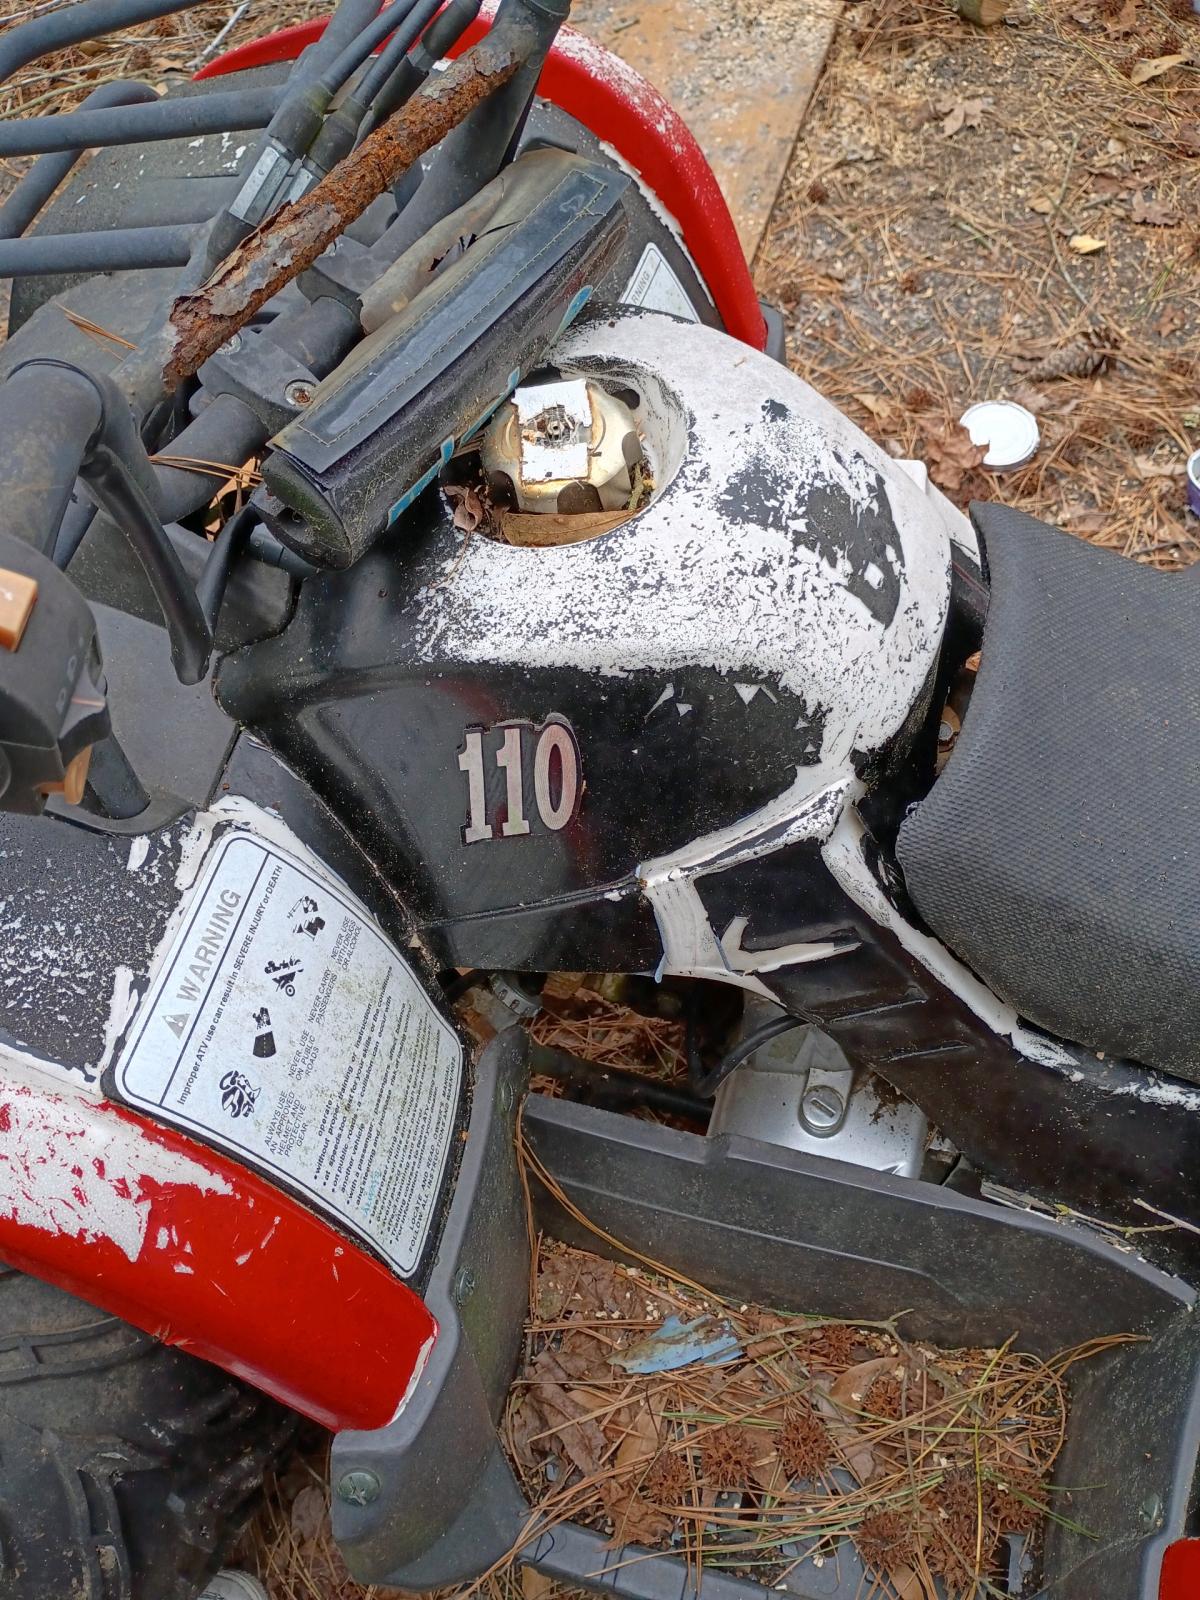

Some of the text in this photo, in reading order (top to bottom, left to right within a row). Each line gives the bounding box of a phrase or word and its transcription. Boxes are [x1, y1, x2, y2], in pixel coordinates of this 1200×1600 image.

[631, 271, 651, 304] RNING
[458, 724, 578, 844] 110
[178, 888, 240, 1003] WARNING
[331, 916, 350, 959] NEVER USE
[335, 920, 355, 965] WITH DRUGS
[340, 926, 361, 970] OR ALCOHOL
[177, 1062, 200, 1104] Improper
[196, 1041, 208, 1061] ATV
[205, 1025, 216, 1041] use
[213, 1007, 223, 1024] can
[220, 980, 234, 1006] result
[229, 970, 238, 980] in
[234, 935, 253, 970] SEVERE
[249, 903, 265, 934] INJURY
[266, 865, 282, 894] DEATH
[308, 966, 331, 1023] NEVER CARRY
[315, 973, 337, 1023] PASSENGERS
[288, 1029, 309, 1078] NEVER USE
[294, 1035, 315, 1081] ON PUBLIC
[305, 1047, 319, 1076] ROADS
[329, 1133, 341, 1166] speeds
[344, 1094, 353, 1112] fast
[355, 1058, 364, 1080] your
[361, 1036, 371, 1058] skills
[377, 966, 392, 1007] conditions
[315, 1138, 330, 1173] without
[328, 1103, 340, 1135] proper
[338, 1066, 353, 1099] training
[354, 1003, 371, 1048] instruction
[337, 1144, 348, 1173] public
[347, 1114, 357, 1139] roads
[360, 1060, 373, 1097] collision
[378, 1013, 387, 1037] occur
[348, 1179, 357, 1198] with
[374, 1064, 390, 1115] passengers
[389, 1036, 398, 1060] affect
[395, 1003, 406, 1033] balance
[264, 1091, 287, 1146] ALWAYS USE
[268, 1091, 294, 1154] AN APPROVED
[277, 1099, 300, 1155] HELMET AND
[284, 1104, 306, 1157] PROTECTIVE
[296, 1122, 308, 1146] GEAR
[341, 1123, 364, 1193] another vehicle
